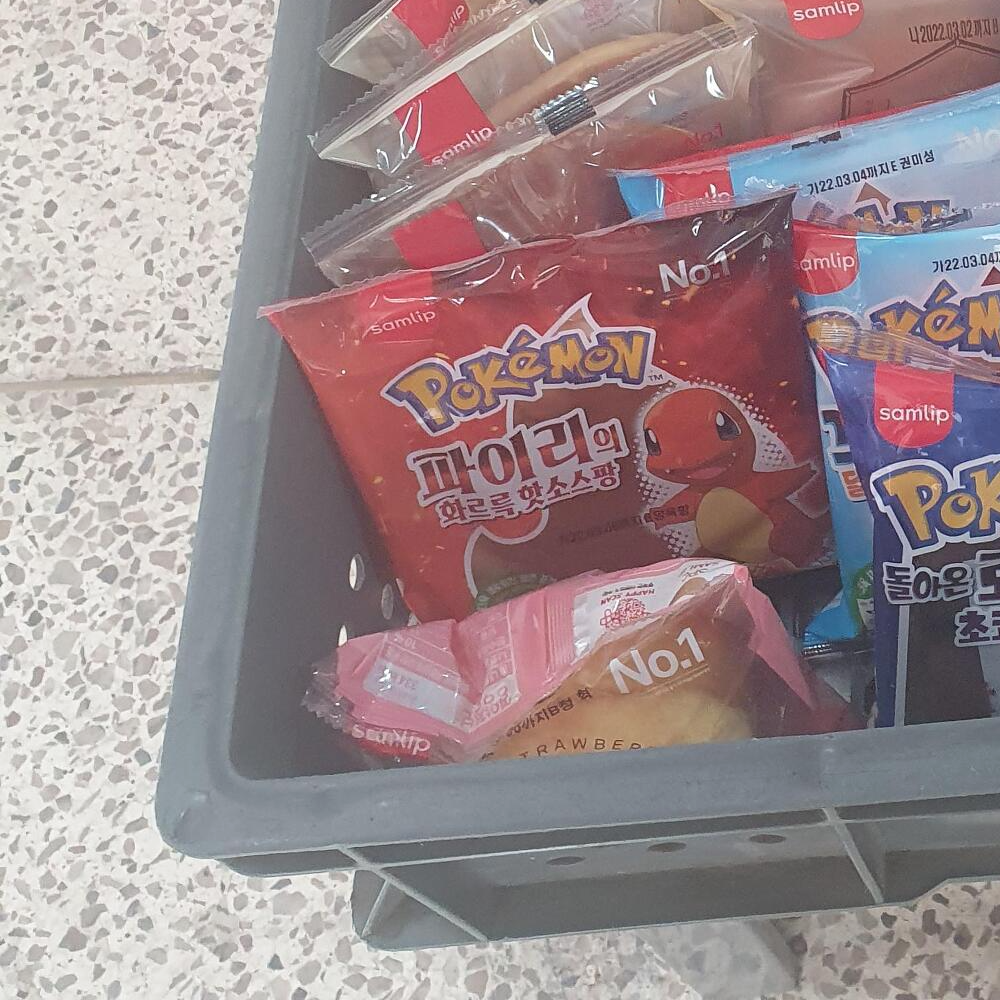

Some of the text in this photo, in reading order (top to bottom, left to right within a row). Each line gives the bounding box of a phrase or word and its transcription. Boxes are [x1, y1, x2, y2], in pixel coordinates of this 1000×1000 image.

[793, 1, 860, 21] samlip
[431, 126, 495, 165] samlip
[899, 149, 935, 170] 권미성
[659, 252, 734, 293] No.1
[799, 249, 856, 273] amlip
[370, 309, 437, 335] samlip
[879, 404, 950, 425] samlip
[411, 411, 625, 503] 파이리의
[440, 464, 617, 524] 화르륵 핫소스팡
[885, 563, 972, 602] 돌아온
[609, 627, 707, 694] No.1
